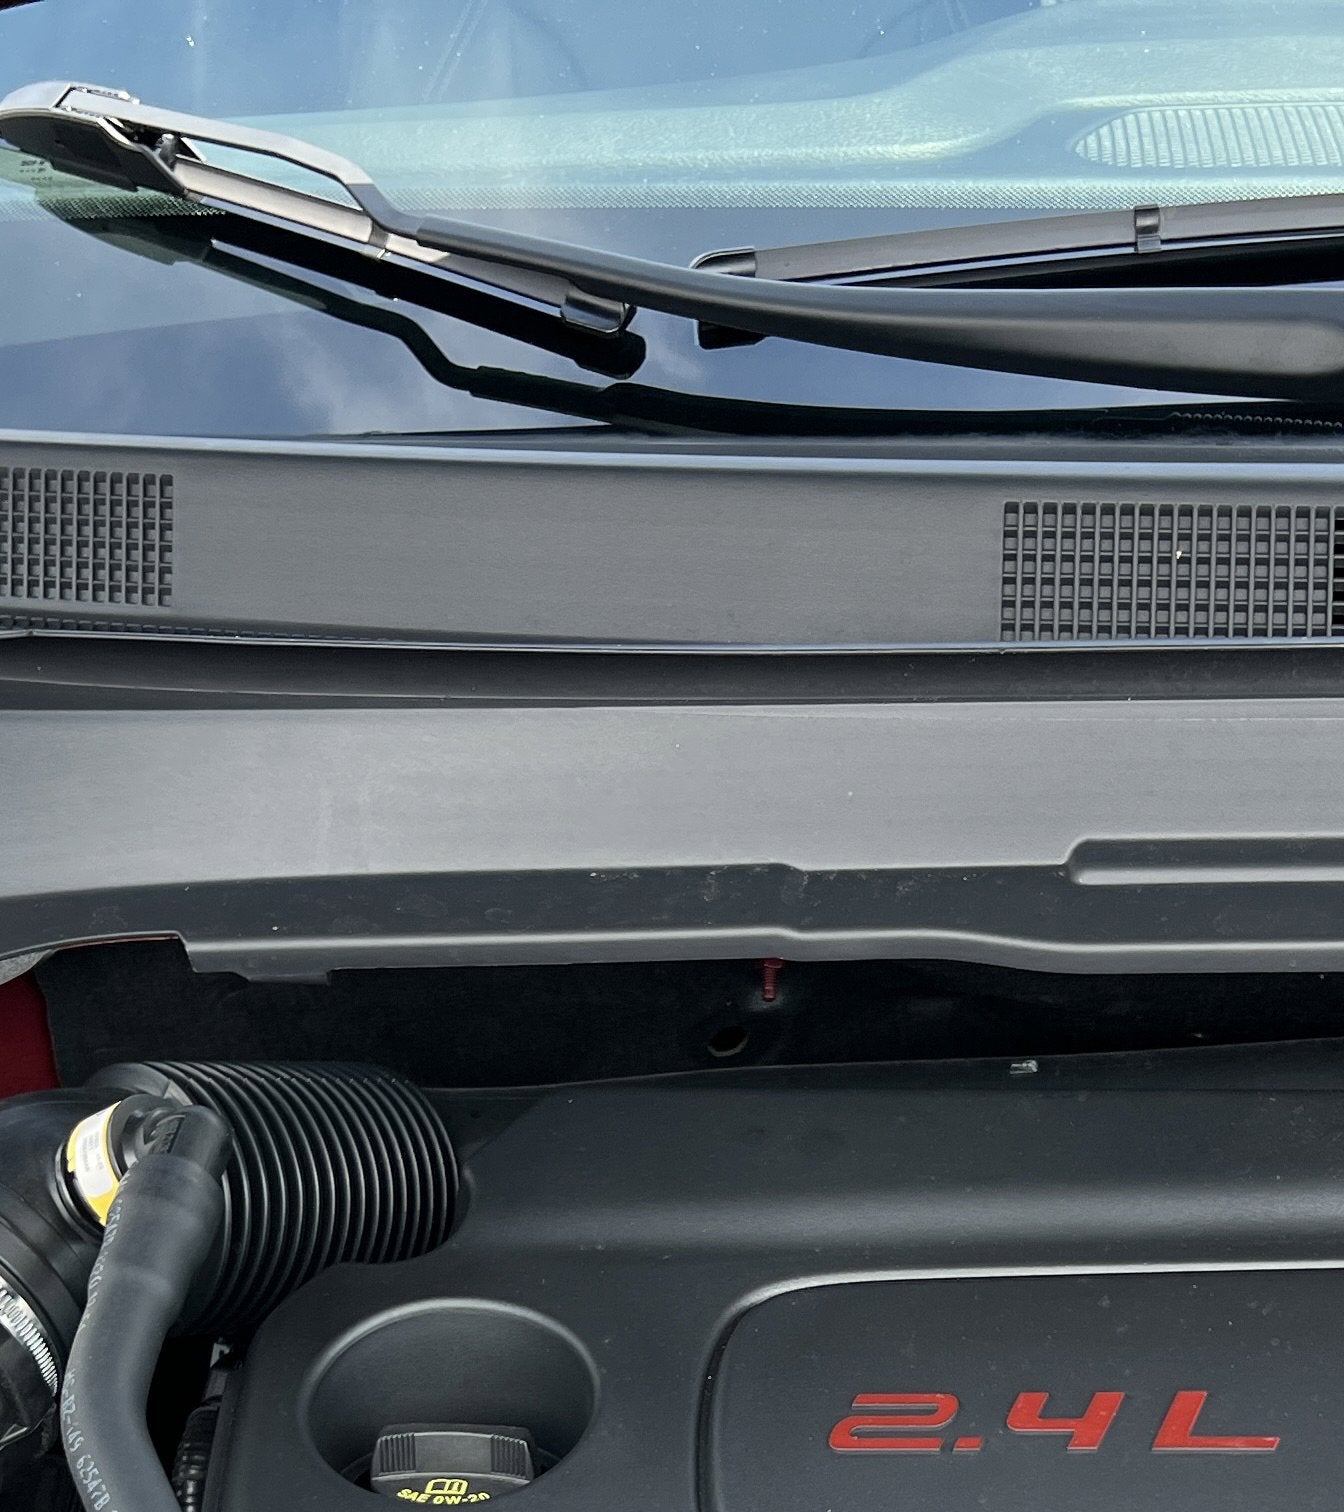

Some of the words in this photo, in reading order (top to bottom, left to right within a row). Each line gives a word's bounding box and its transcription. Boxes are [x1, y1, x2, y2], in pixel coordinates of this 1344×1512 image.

[829, 1391, 1125, 1451] 2.4
[1152, 1390, 1280, 1451] L
[397, 1488, 431, 1502] SAE
